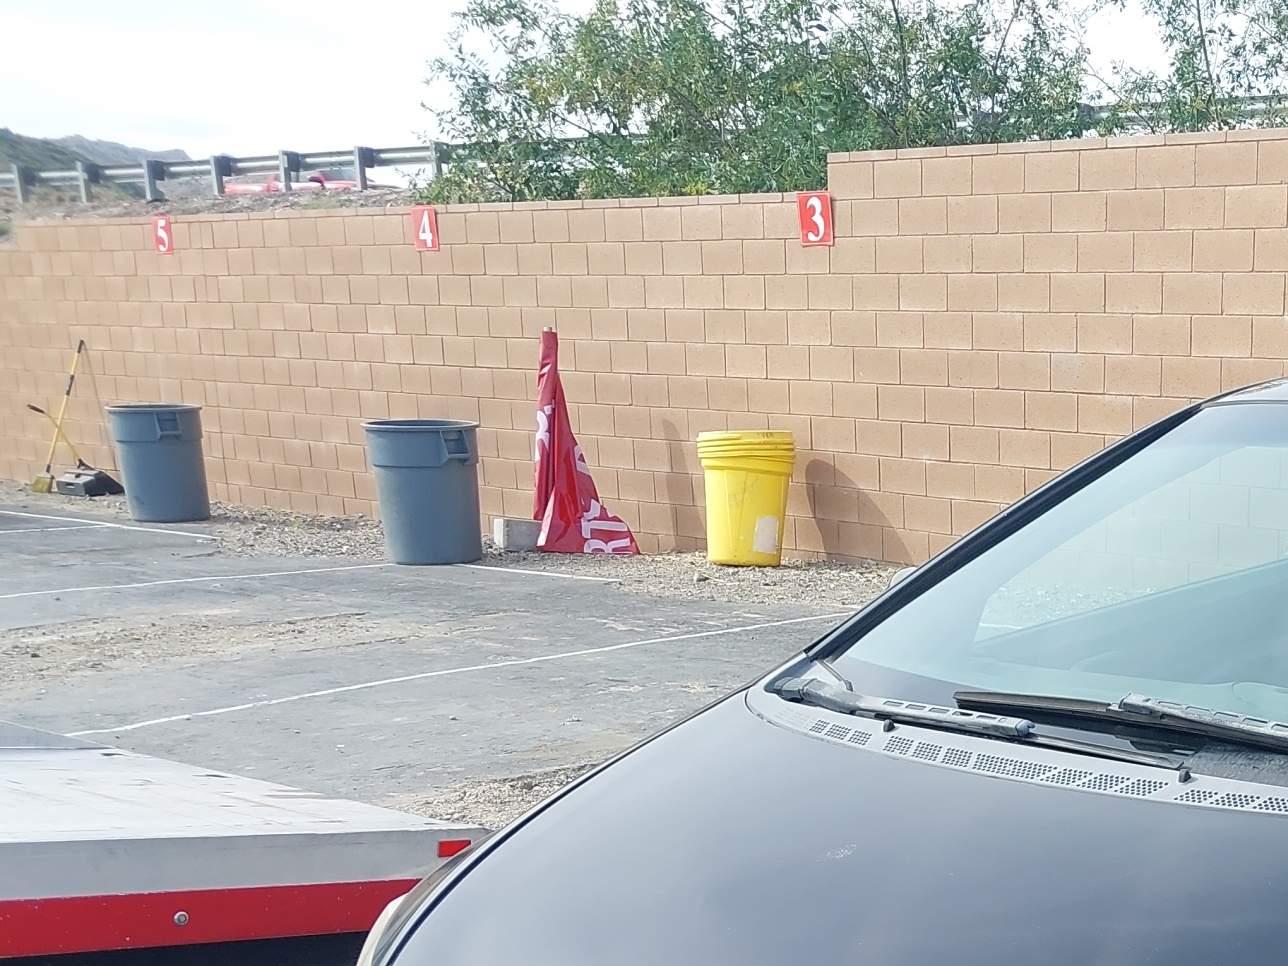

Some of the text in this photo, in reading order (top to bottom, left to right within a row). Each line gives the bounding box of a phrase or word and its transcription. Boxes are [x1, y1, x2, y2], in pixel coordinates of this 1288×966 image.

[157, 219, 169, 252] 5
[418, 210, 434, 248] 4
[806, 196, 825, 243] 3
